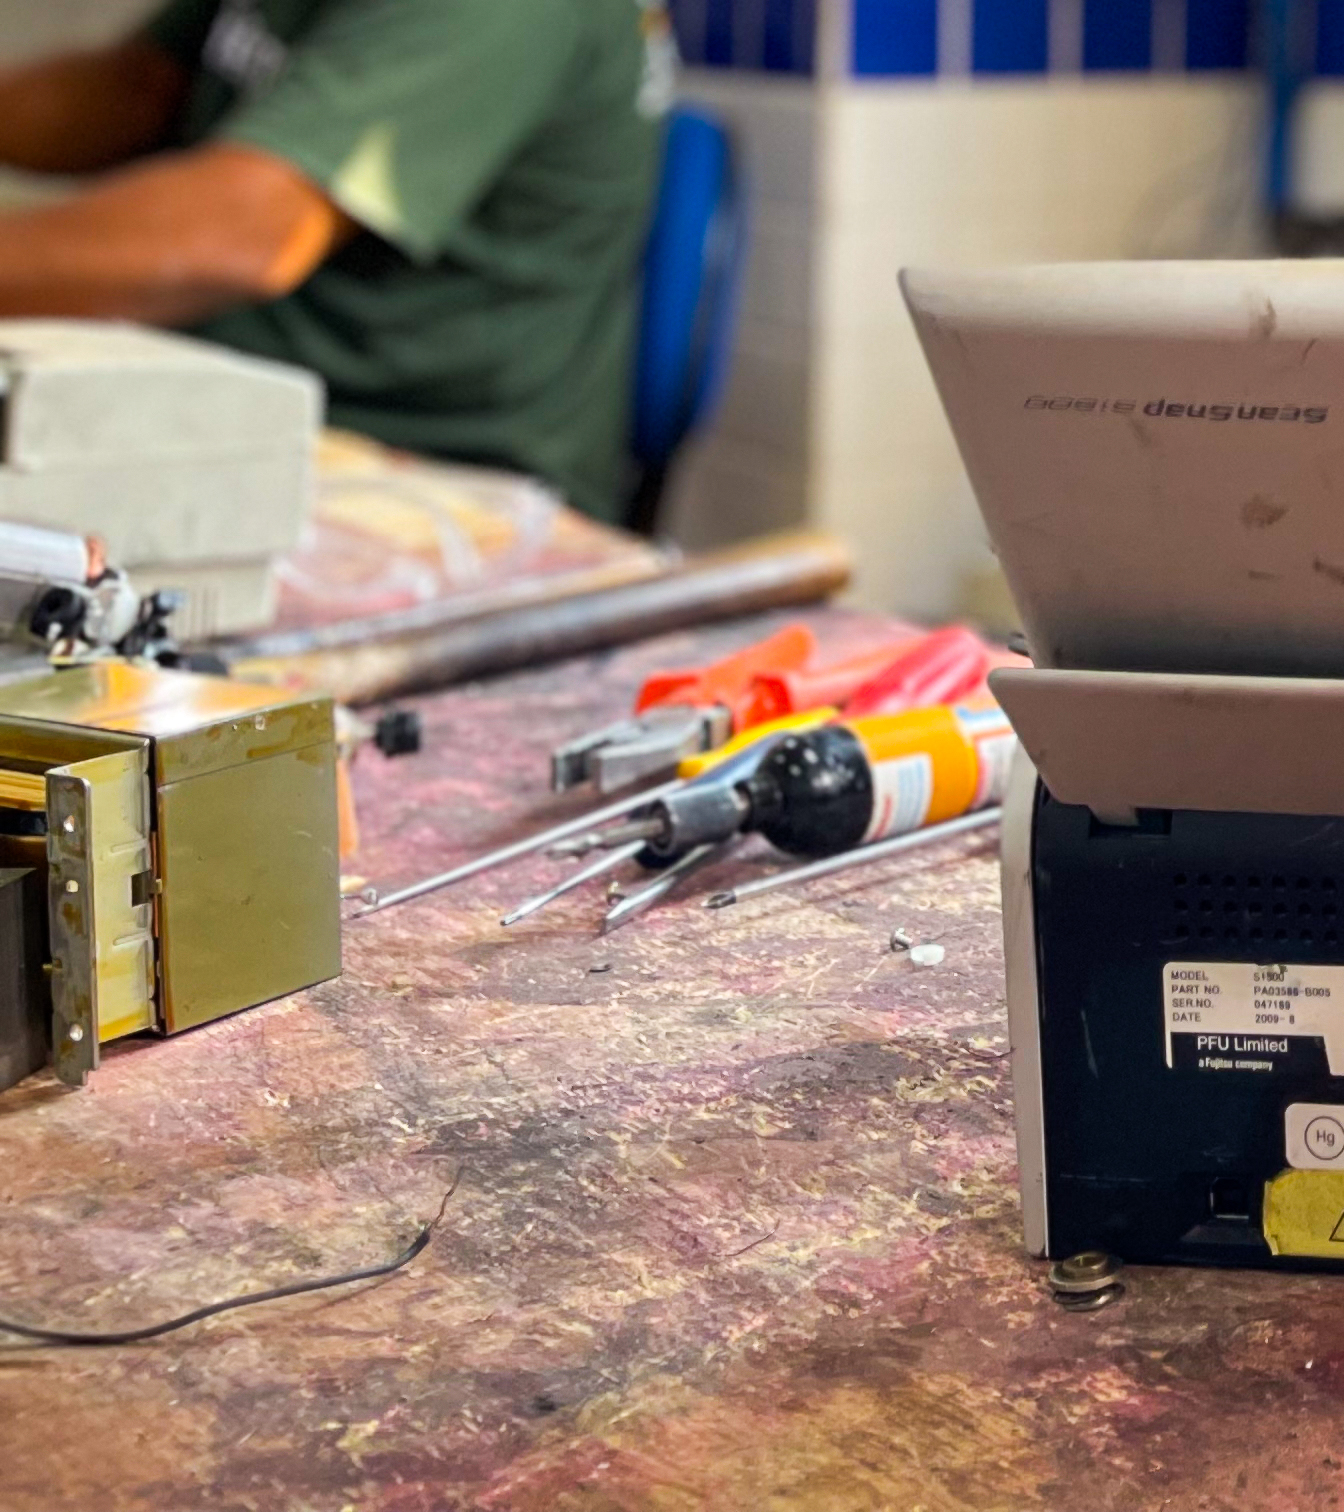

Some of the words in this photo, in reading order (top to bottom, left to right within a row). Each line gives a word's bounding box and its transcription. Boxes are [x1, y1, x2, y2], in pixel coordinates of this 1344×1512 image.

[1142, 396, 1330, 425] ScanSnap
[1171, 970, 1208, 981] MODEL
[1171, 984, 1199, 994] PART
[1172, 1012, 1201, 1022] DATE
[1197, 1035, 1230, 1051] PFU
[1234, 1036, 1288, 1053] Limited
[1316, 1129, 1336, 1147] Hg
